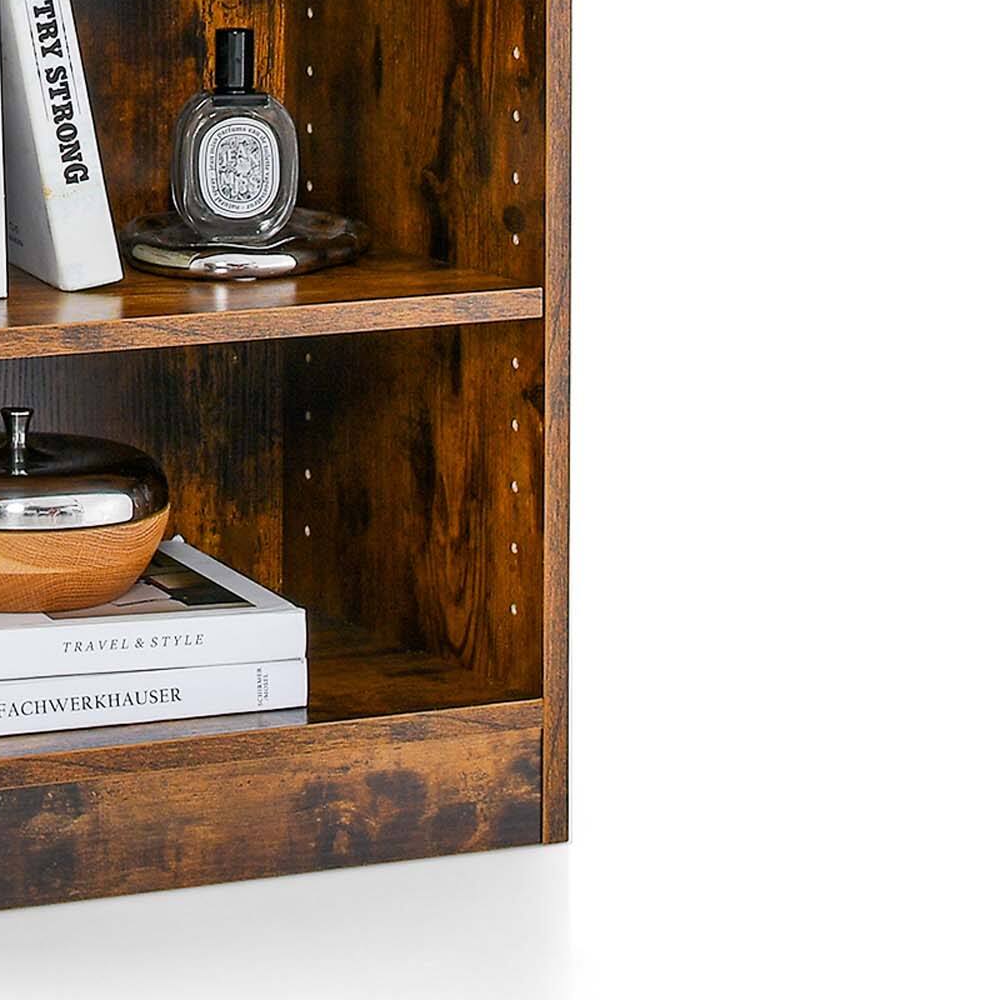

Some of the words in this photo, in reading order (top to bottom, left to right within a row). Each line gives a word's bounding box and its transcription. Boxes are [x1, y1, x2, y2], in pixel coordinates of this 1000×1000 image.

[45, 65, 90, 185] STRONG
[62, 638, 130, 654] TRAVEL
[134, 637, 145, 649] &
[149, 633, 205, 648] STYLE
